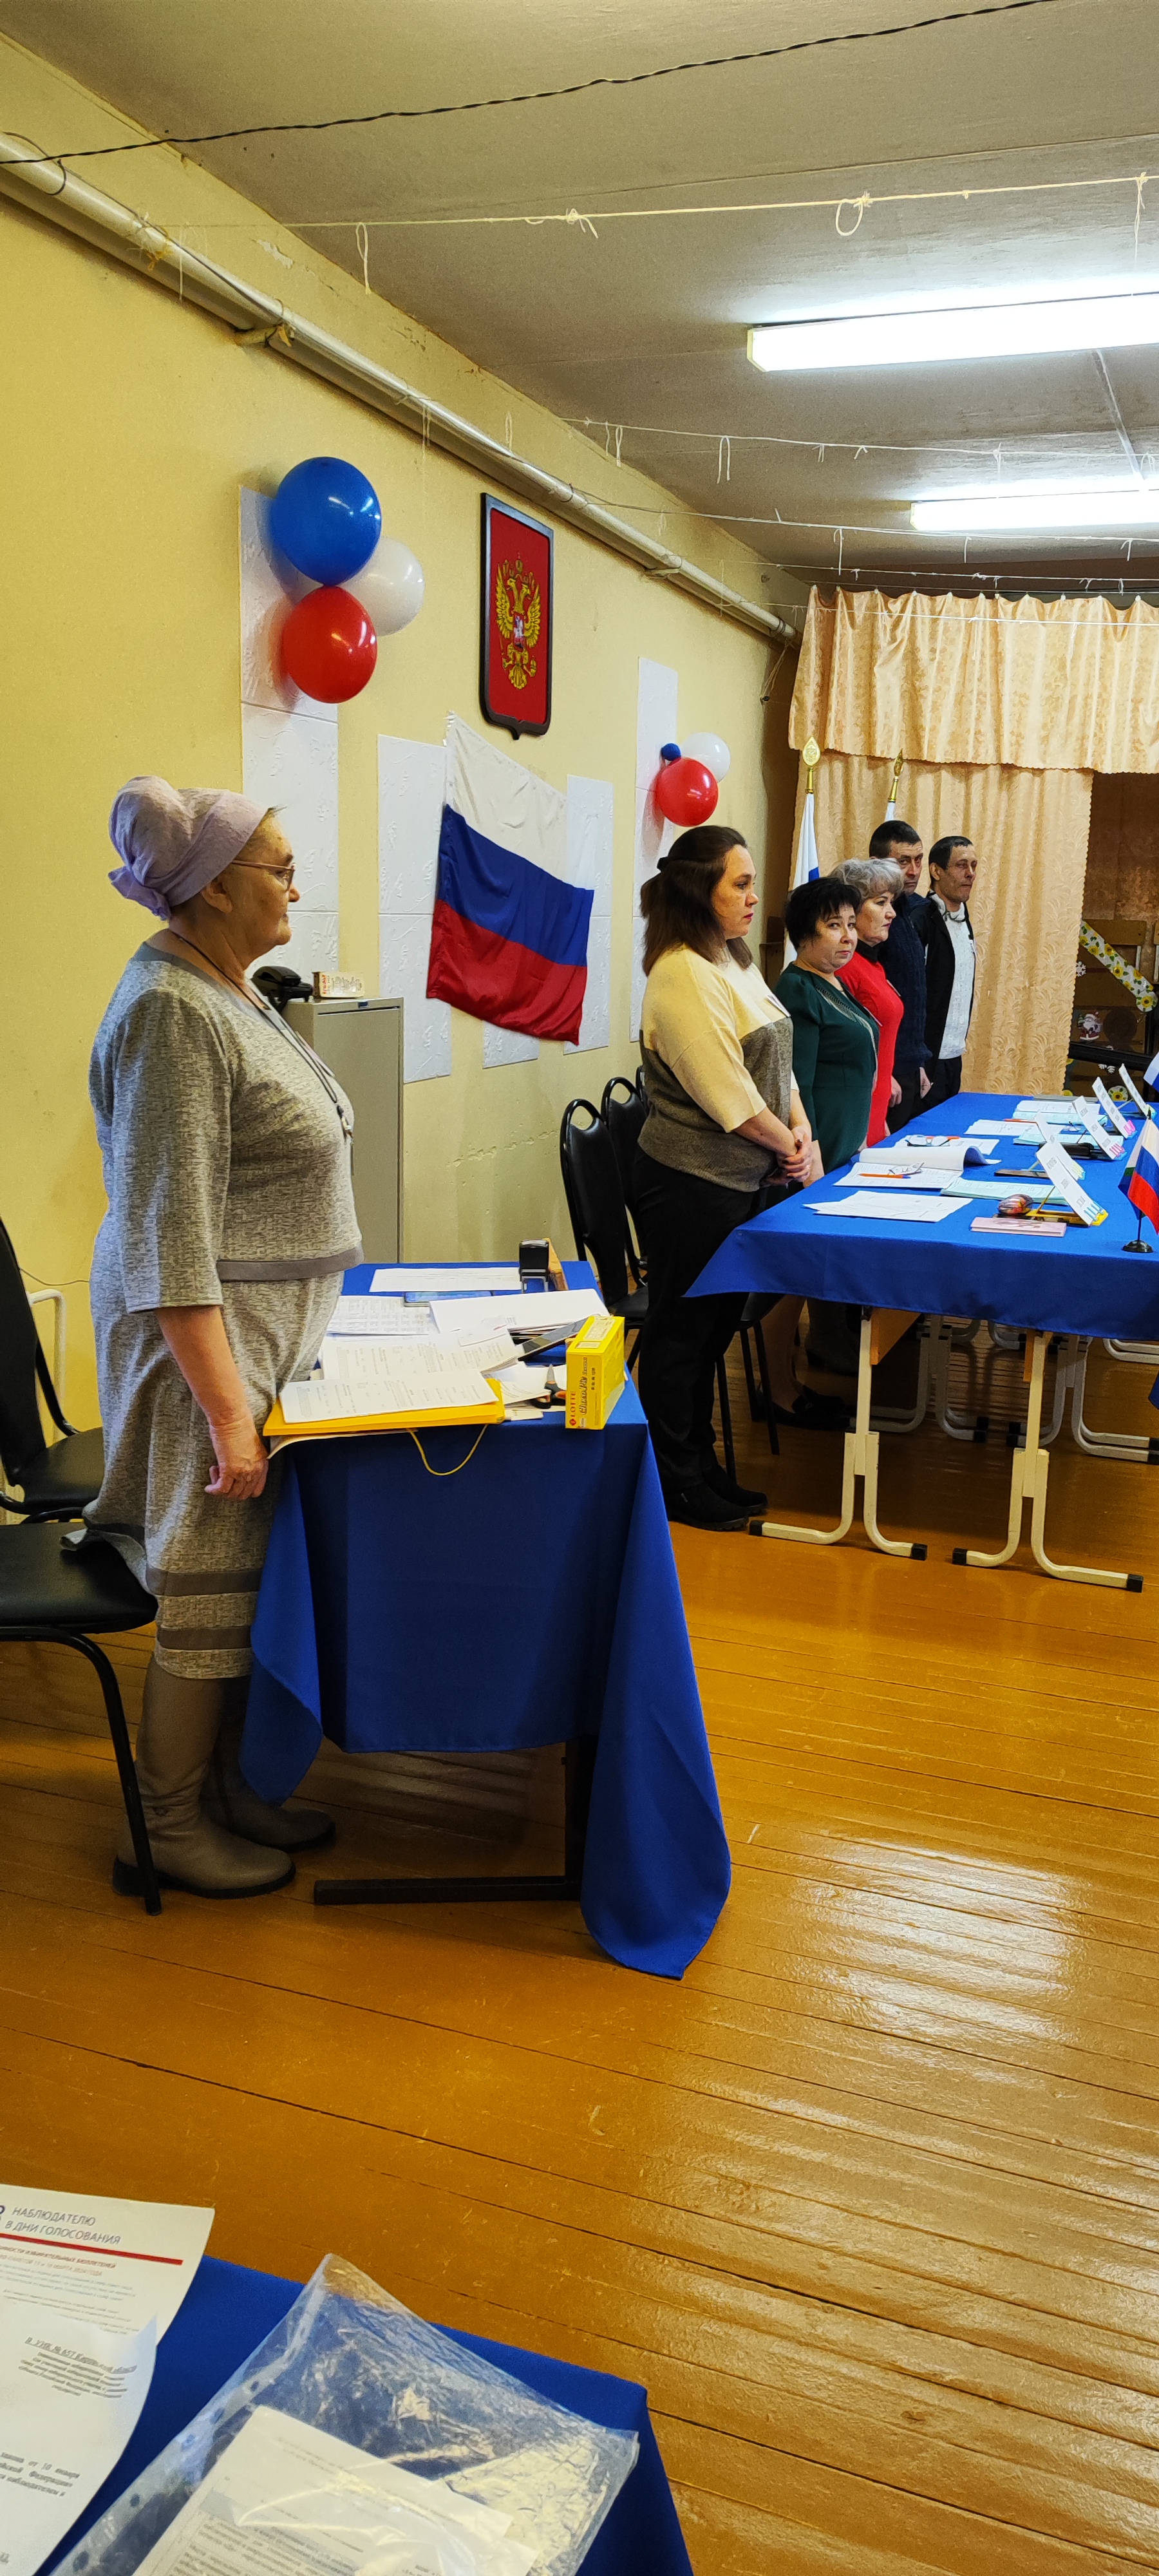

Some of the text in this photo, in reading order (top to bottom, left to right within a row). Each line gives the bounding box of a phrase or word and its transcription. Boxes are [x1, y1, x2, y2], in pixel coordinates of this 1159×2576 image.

[12, 2207, 96, 2226] НАБЛЮДАТЕЛЮ
[5, 2221, 121, 2244] В ДНИ ГОЛОСОВАНИЯ
